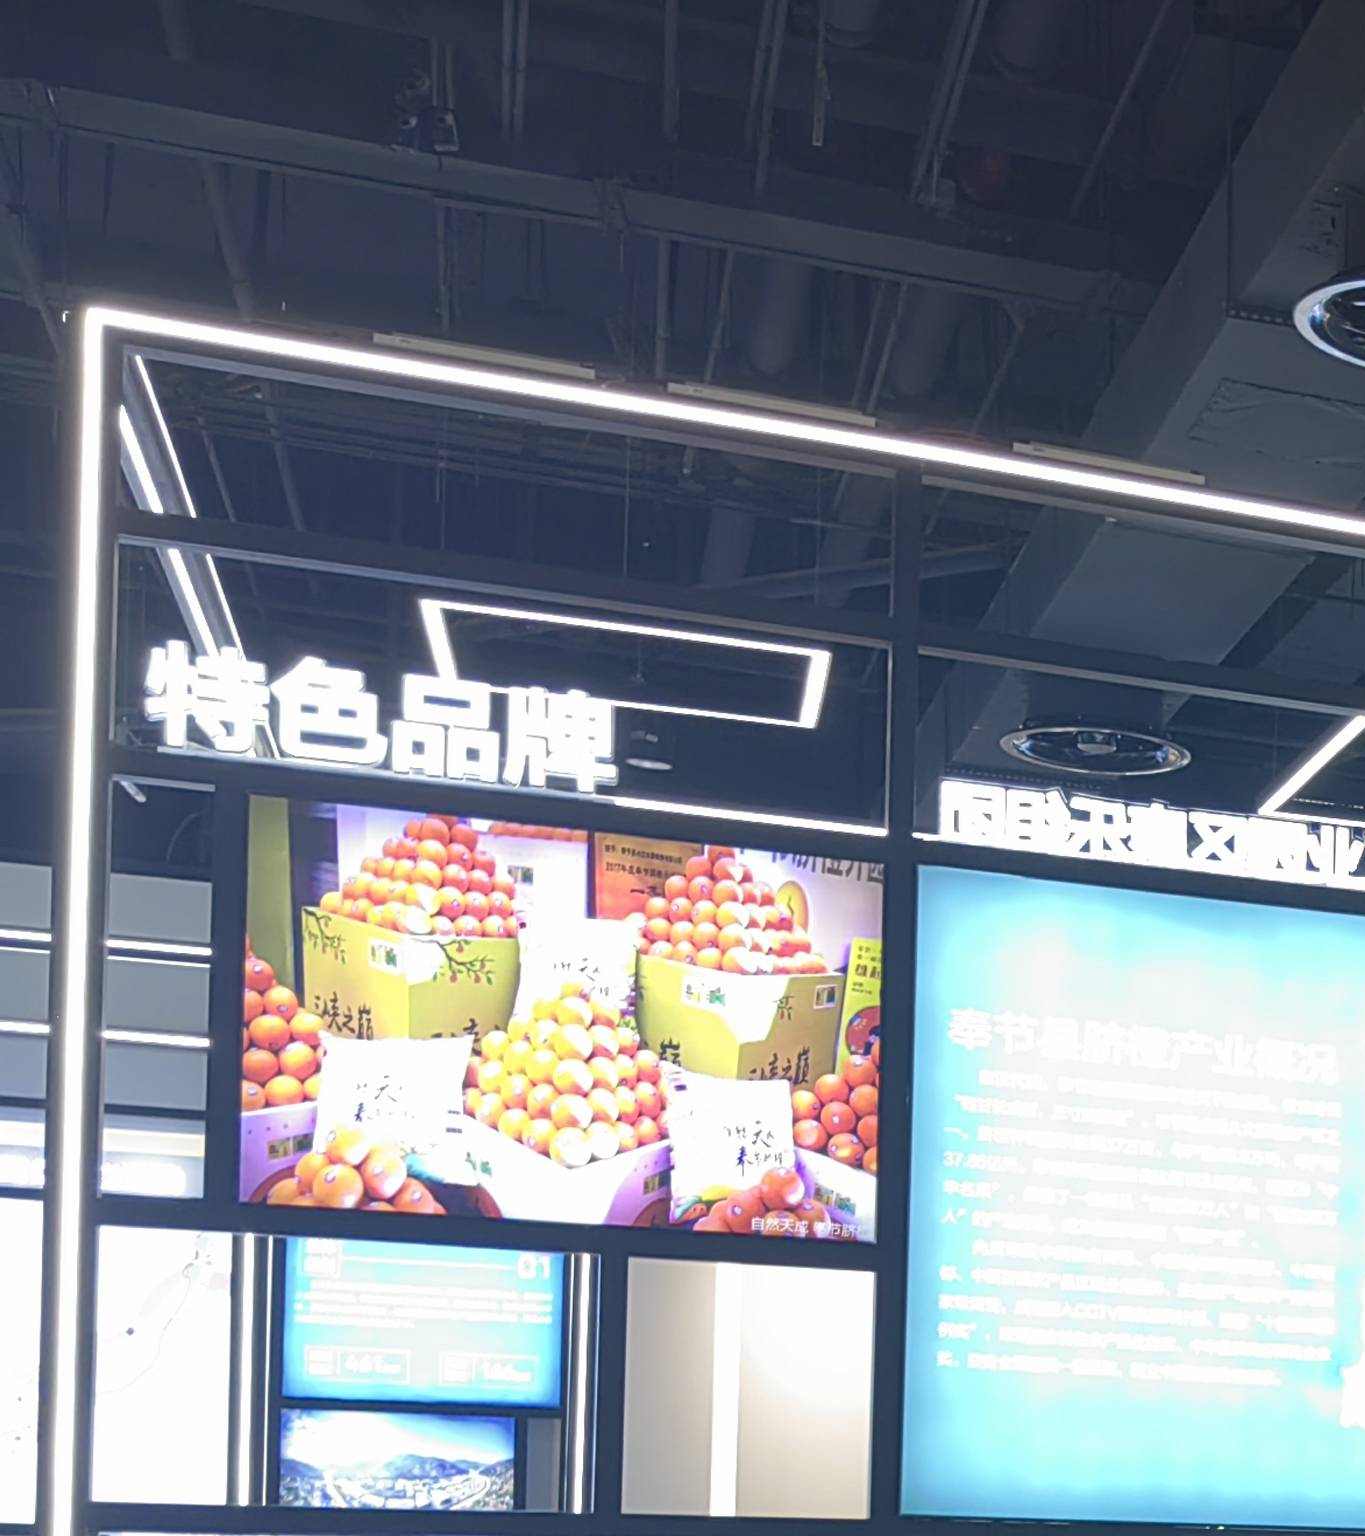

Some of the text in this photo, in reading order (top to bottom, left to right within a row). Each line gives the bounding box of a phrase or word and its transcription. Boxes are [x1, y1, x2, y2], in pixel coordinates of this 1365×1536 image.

[145, 639, 618, 794] 特色品牌
[751, 1217, 809, 1234] 自然天成
